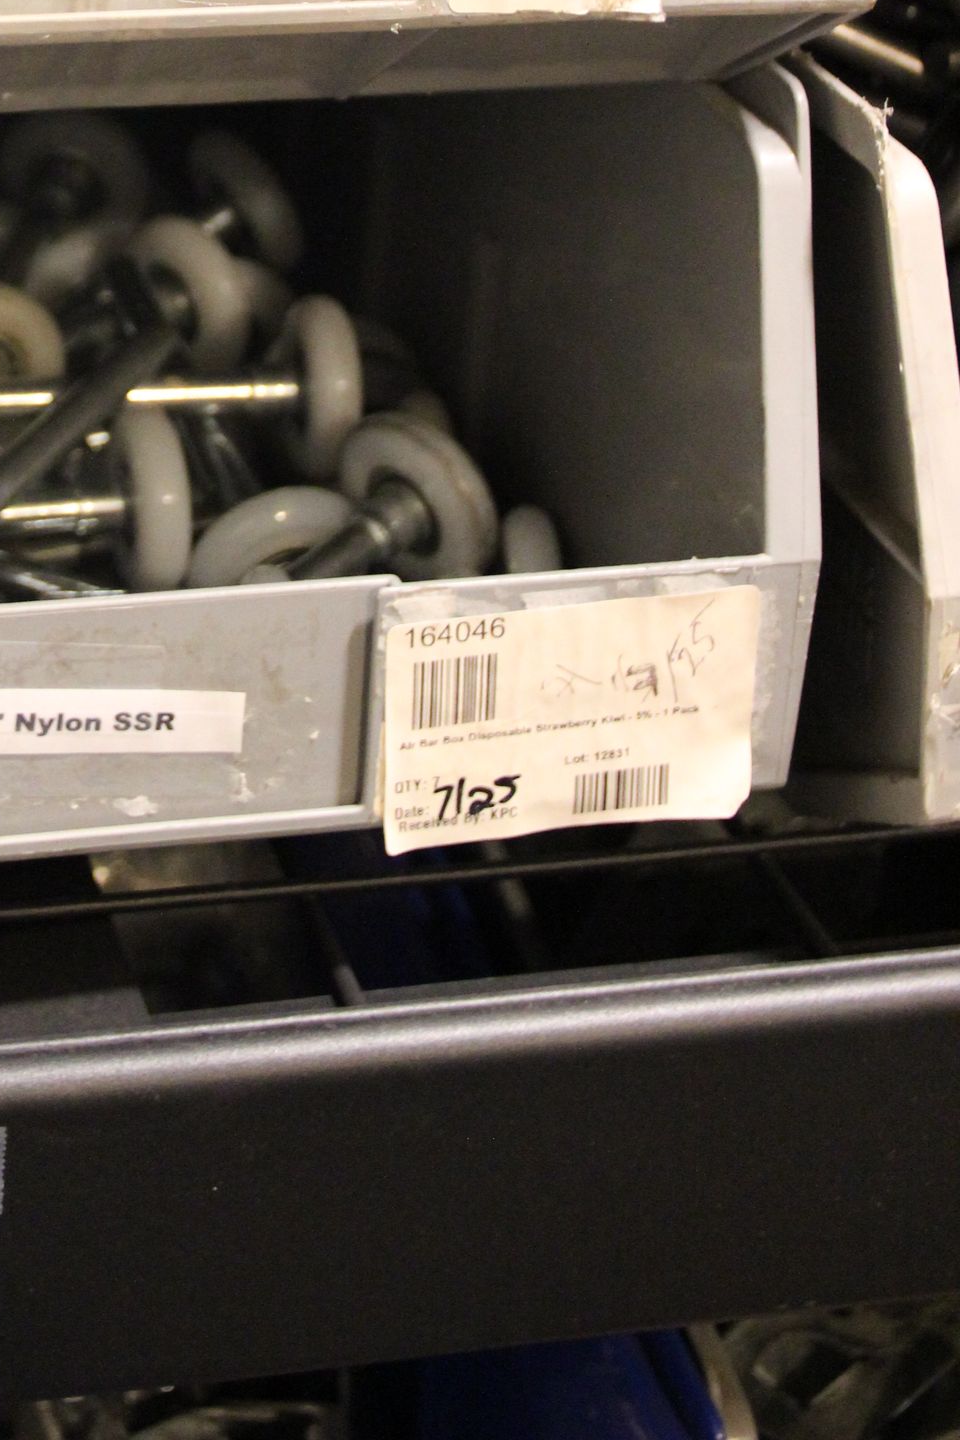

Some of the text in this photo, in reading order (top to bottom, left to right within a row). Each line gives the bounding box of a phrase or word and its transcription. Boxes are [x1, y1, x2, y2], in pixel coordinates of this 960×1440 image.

[405, 617, 506, 649] 164046
[15, 713, 102, 737] Nylon
[113, 712, 176, 732] SSR
[394, 805, 429, 820] Date:
